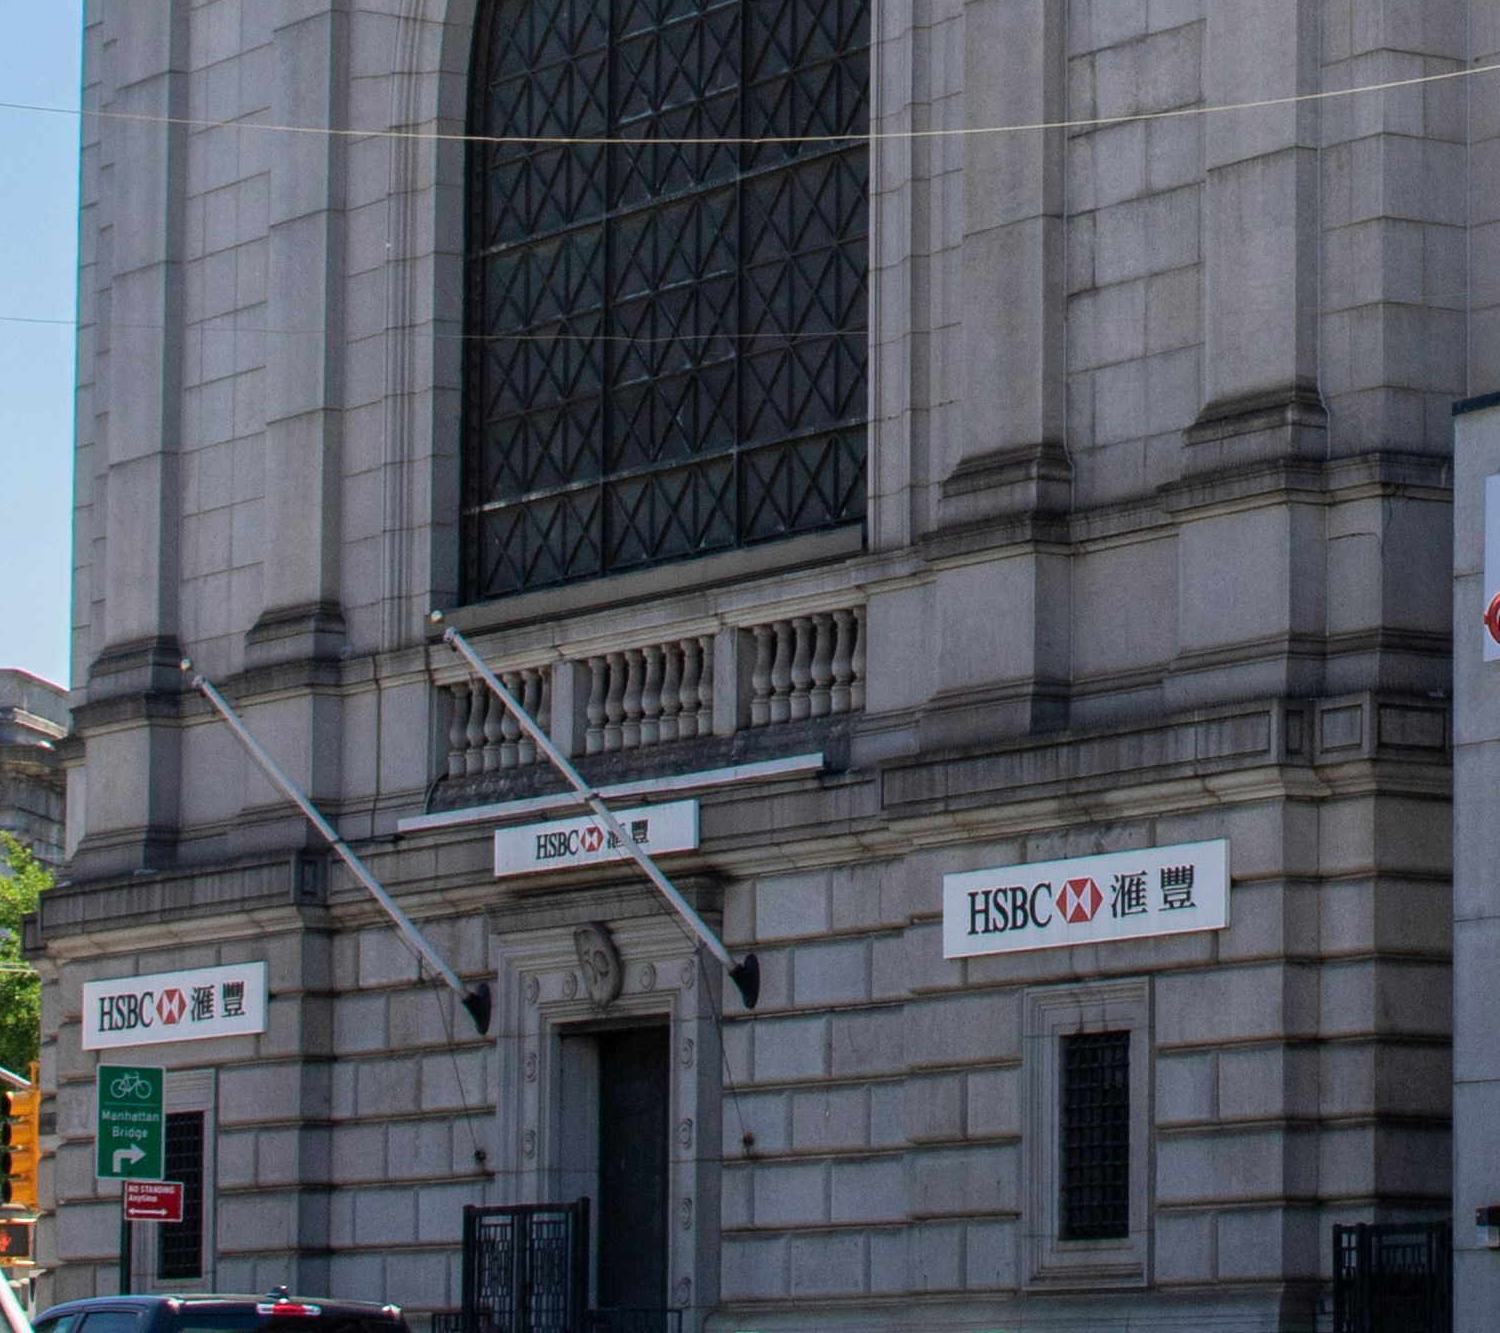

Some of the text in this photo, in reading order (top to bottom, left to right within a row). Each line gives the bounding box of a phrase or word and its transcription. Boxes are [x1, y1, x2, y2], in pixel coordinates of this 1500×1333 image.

[535, 830, 579, 860] HSBC
[967, 881, 1053, 936] HSBC
[97, 991, 154, 1032] HSBC
[101, 1109, 160, 1122] Manhattan
[111, 1126, 149, 1141] Bridge
[128, 1185, 176, 1194] NO STANDING
[128, 1194, 158, 1203] Anytime
